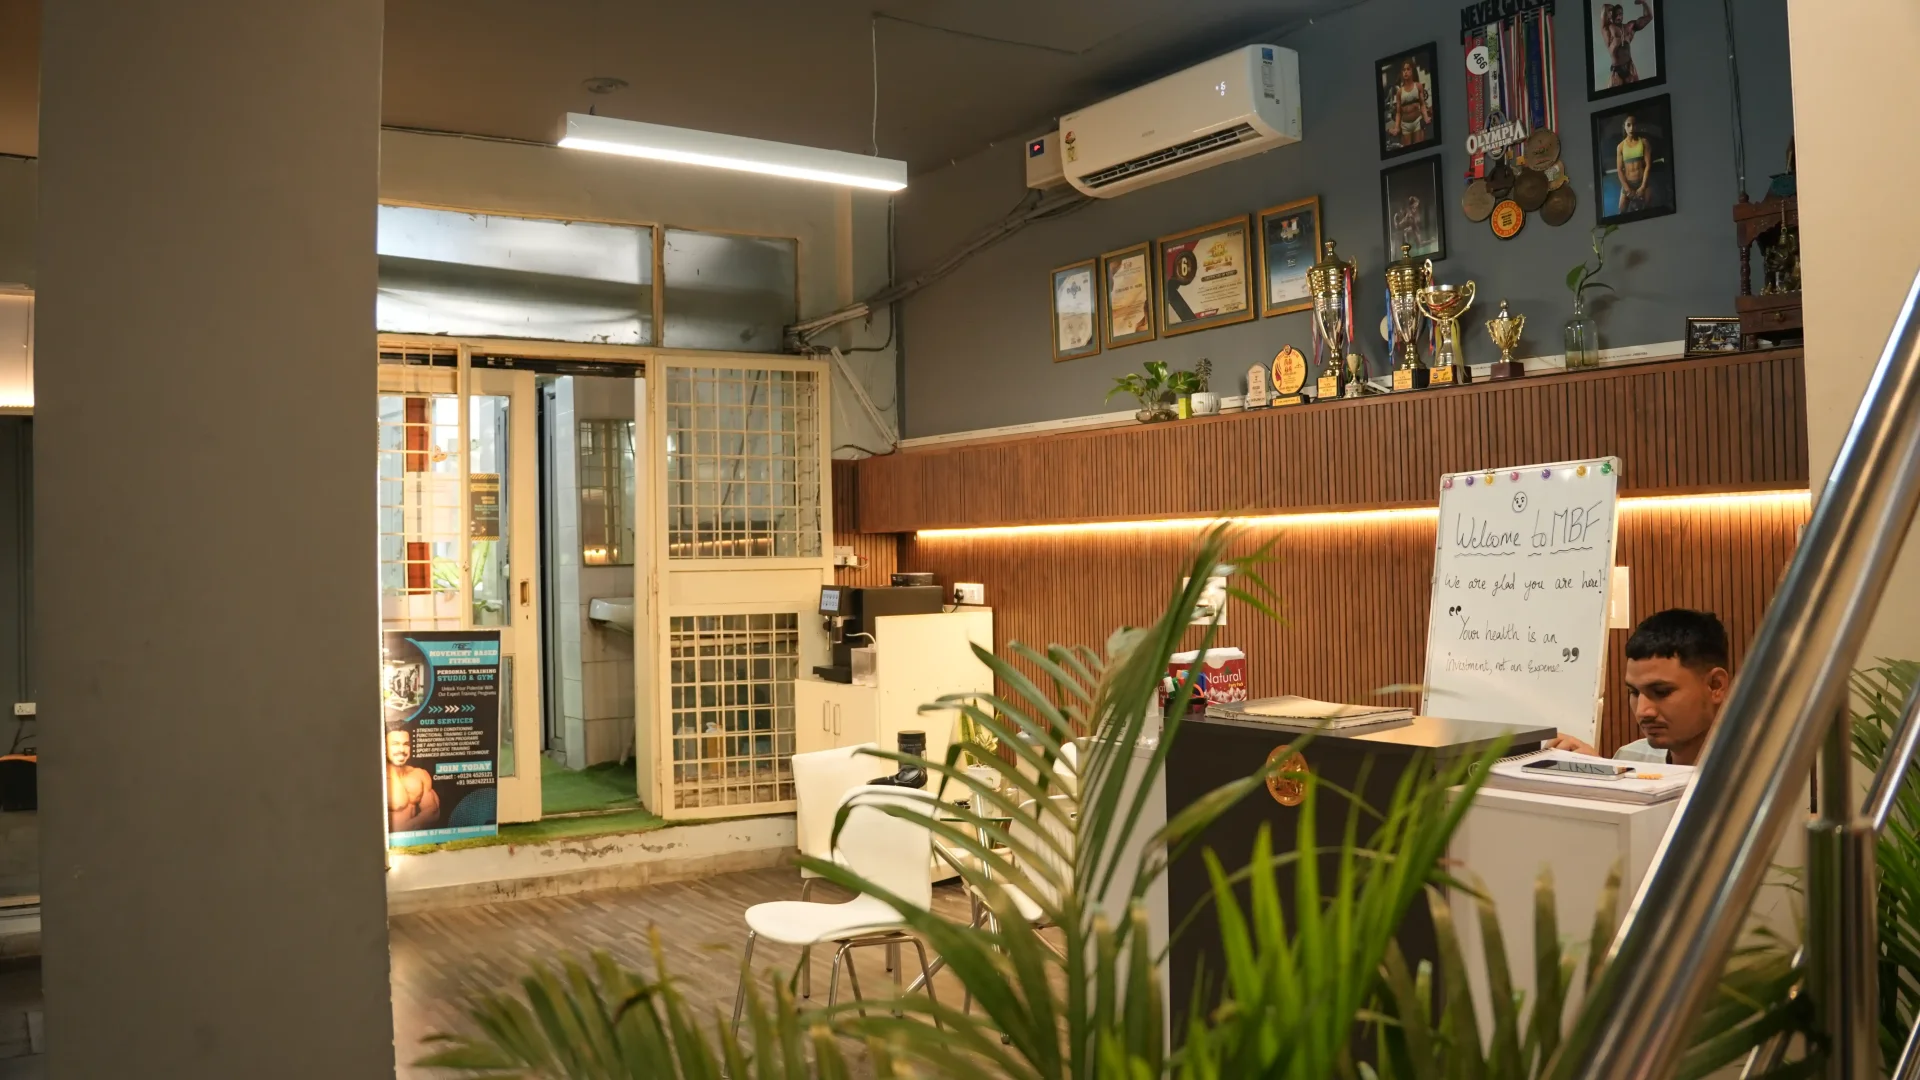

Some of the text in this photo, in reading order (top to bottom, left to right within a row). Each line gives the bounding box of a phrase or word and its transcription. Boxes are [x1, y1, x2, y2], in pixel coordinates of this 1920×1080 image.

[1473, 53, 1488, 69] 466
[1466, 120, 1526, 155] OLYMPIA
[1482, 138, 1512, 152] AMATEUR
[1456, 500, 1603, 549] Welcome to MBF
[1468, 578, 1487, 590] are
[1492, 572, 1516, 596] glad
[1524, 580, 1545, 601] you
[1555, 577, 1573, 589] are
[1485, 619, 1519, 641] health
[1528, 626, 1537, 643] is
[1543, 633, 1558, 644] an
[449, 657, 480, 665] FITNESS
[1495, 659, 1511, 672] not
[1510, 663, 1523, 673] an
[1205, 669, 1242, 684] Natural
[437, 717, 474, 725] SERVICES
[436, 763, 491, 773] JOIN TODAY
